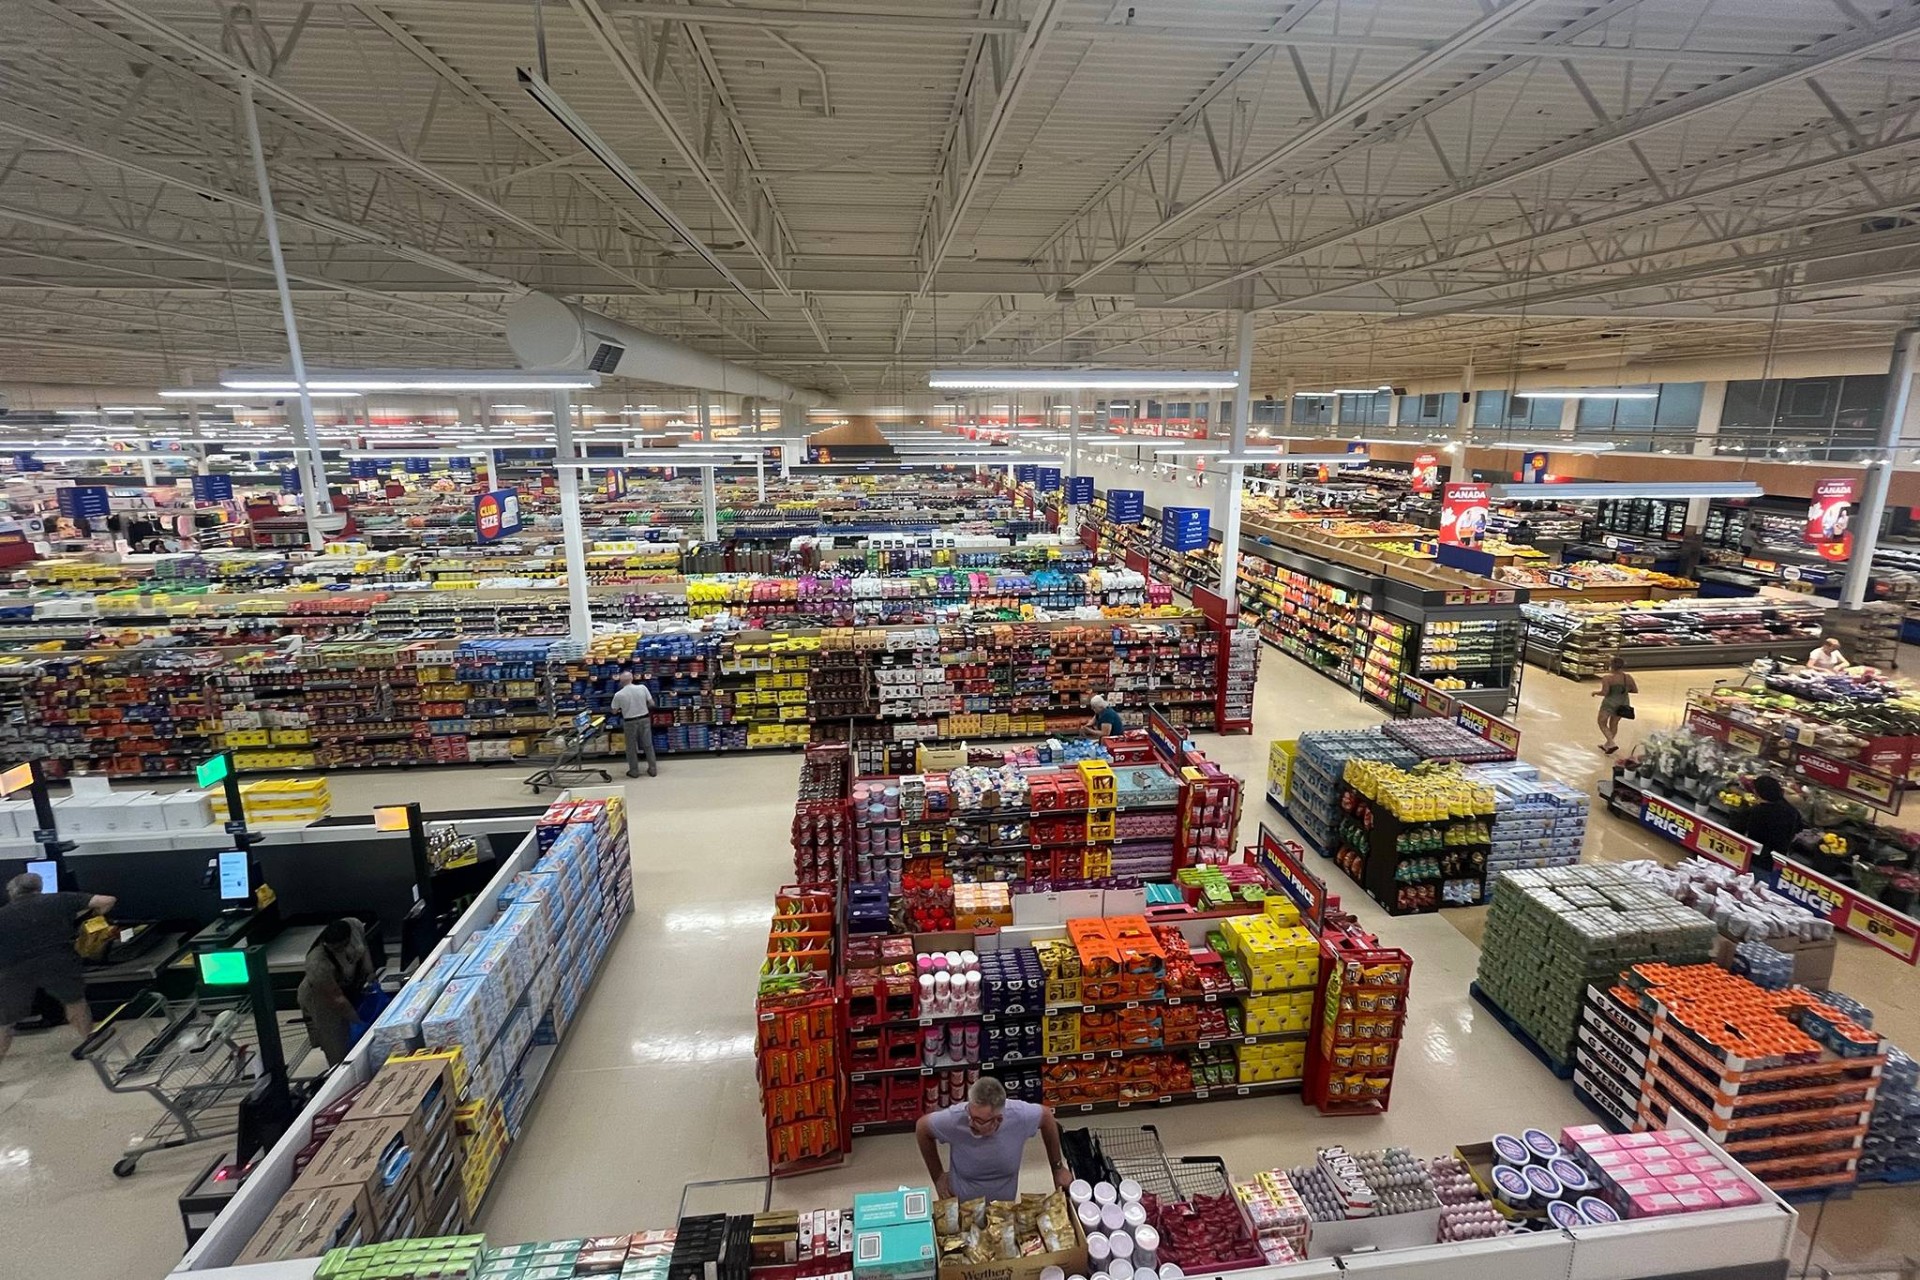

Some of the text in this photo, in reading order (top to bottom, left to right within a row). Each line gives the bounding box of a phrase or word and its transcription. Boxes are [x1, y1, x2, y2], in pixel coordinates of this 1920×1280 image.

[1448, 490, 1486, 499] CANADA
[1817, 486, 1852, 494] CANADA
[480, 504, 497, 518] CLUB
[481, 515, 499, 529] SIZE
[1402, 686, 1422, 702] PRICE
[1403, 679, 1426, 697] SUPER
[1459, 716, 1484, 734] PRICE
[1461, 708, 1489, 728] SUPER
[1691, 715, 1722, 731] CANADA
[1799, 755, 1840, 774] CANADA
[1645, 810, 1687, 840] PRICE
[1648, 802, 1695, 833] SUPER
[1267, 848, 1315, 907] SUPER PRICE
[1780, 867, 1845, 909] SUPER
[1777, 877, 1833, 916] PRICE
[1596, 996, 1637, 1033] G ZERO
[1593, 1017, 1633, 1056] G ZERO
[1587, 1036, 1628, 1075] G ZERO
[1584, 1058, 1624, 1097] G ZERO
[1583, 1080, 1592, 1091] G
[1594, 1088, 1624, 1119] ZERO
